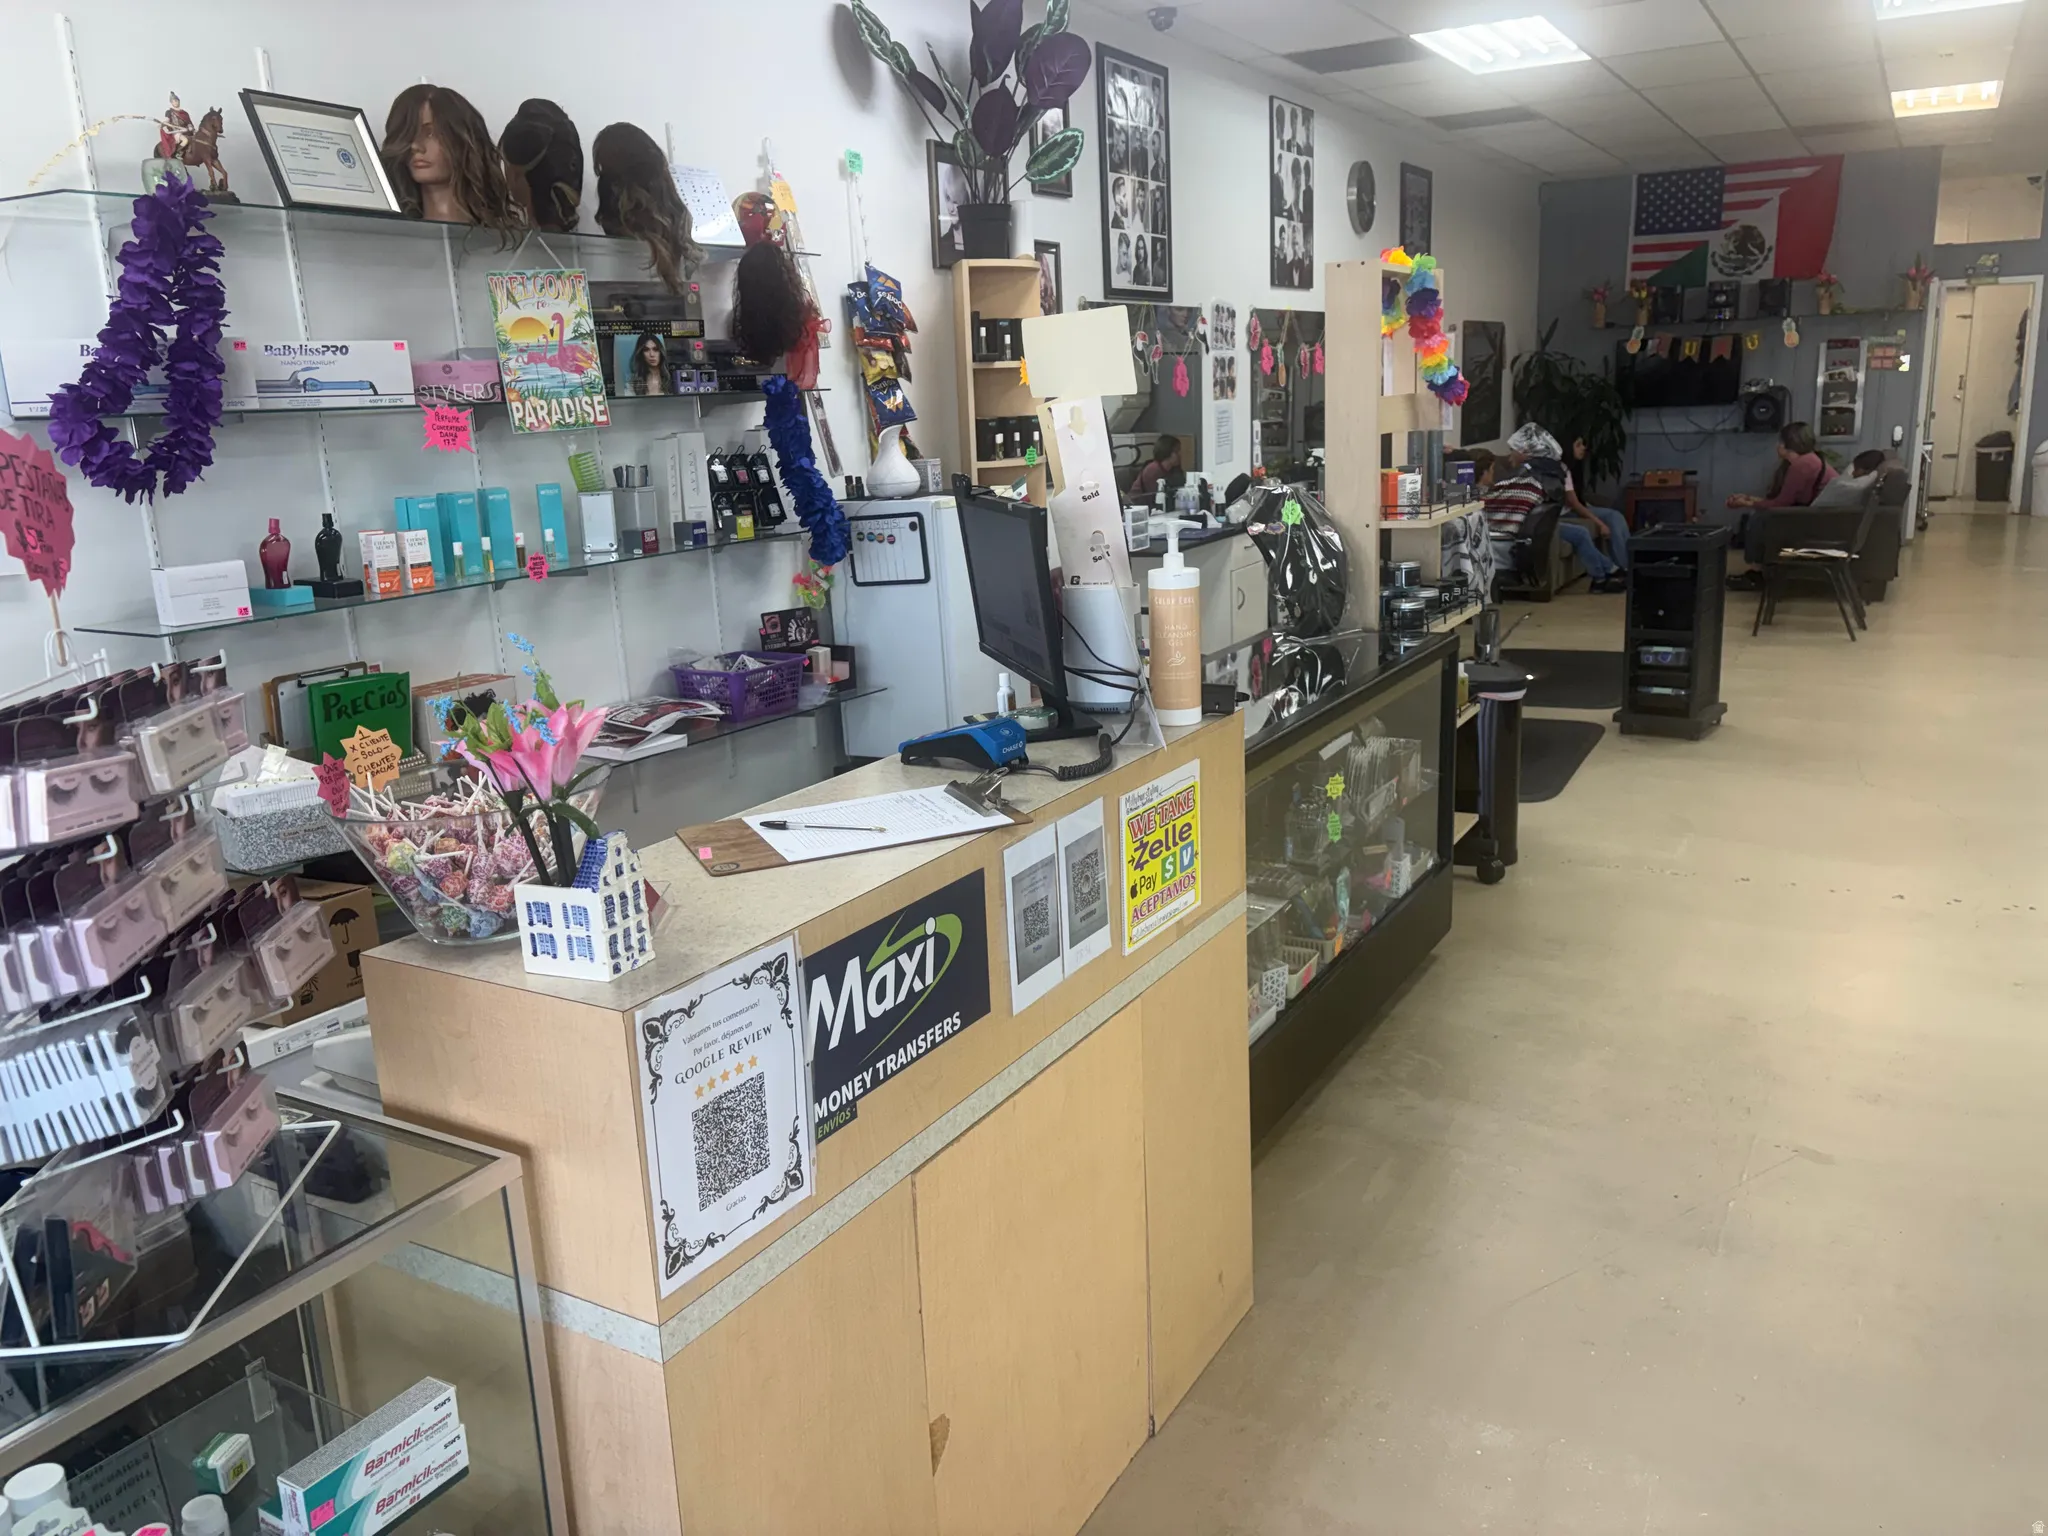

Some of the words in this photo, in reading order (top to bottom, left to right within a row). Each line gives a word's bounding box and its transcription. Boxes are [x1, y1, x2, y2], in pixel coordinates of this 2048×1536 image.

[489, 274, 588, 314] WELCOME
[264, 344, 349, 359] BaBylissPRO
[511, 395, 607, 428] PARADISE
[1081, 490, 1100, 503] Sold
[1155, 629, 1197, 639] CLEANSING
[1168, 639, 1184, 647] GEL
[359, 733, 390, 749] CLIENTE
[1002, 743, 1019, 754] CHASE
[356, 752, 397, 775] CLIENTES
[1129, 807, 1156, 841] WE
[1158, 787, 1195, 828] TAKE
[1134, 821, 1192, 872] Zelle
[1131, 870, 1196, 925] ACEPTAMOS
[1139, 872, 1158, 892] Pay
[807, 916, 937, 1060] Maxi
[682, 1025, 711, 1046] Valoramos
[712, 1020, 721, 1029] tus
[722, 999, 761, 1025] comentarios!
[693, 1046, 703, 1057] Por
[744, 1020, 753, 1030] un
[674, 1048, 725, 1085] GOOGLE
[729, 1023, 773, 1055] REVIEW
[813, 1065, 874, 1123] MONEY
[875, 1011, 961, 1081] TRANSFERS
[817, 1106, 851, 1139] ENVÍOS
[725, 1195, 747, 1212] Gracias
[364, 1427, 421, 1477] Barmicil
[419, 1411, 452, 1438] Compuesto
[376, 1464, 431, 1515] Barmicil
[429, 1450, 462, 1475] Compuesto
